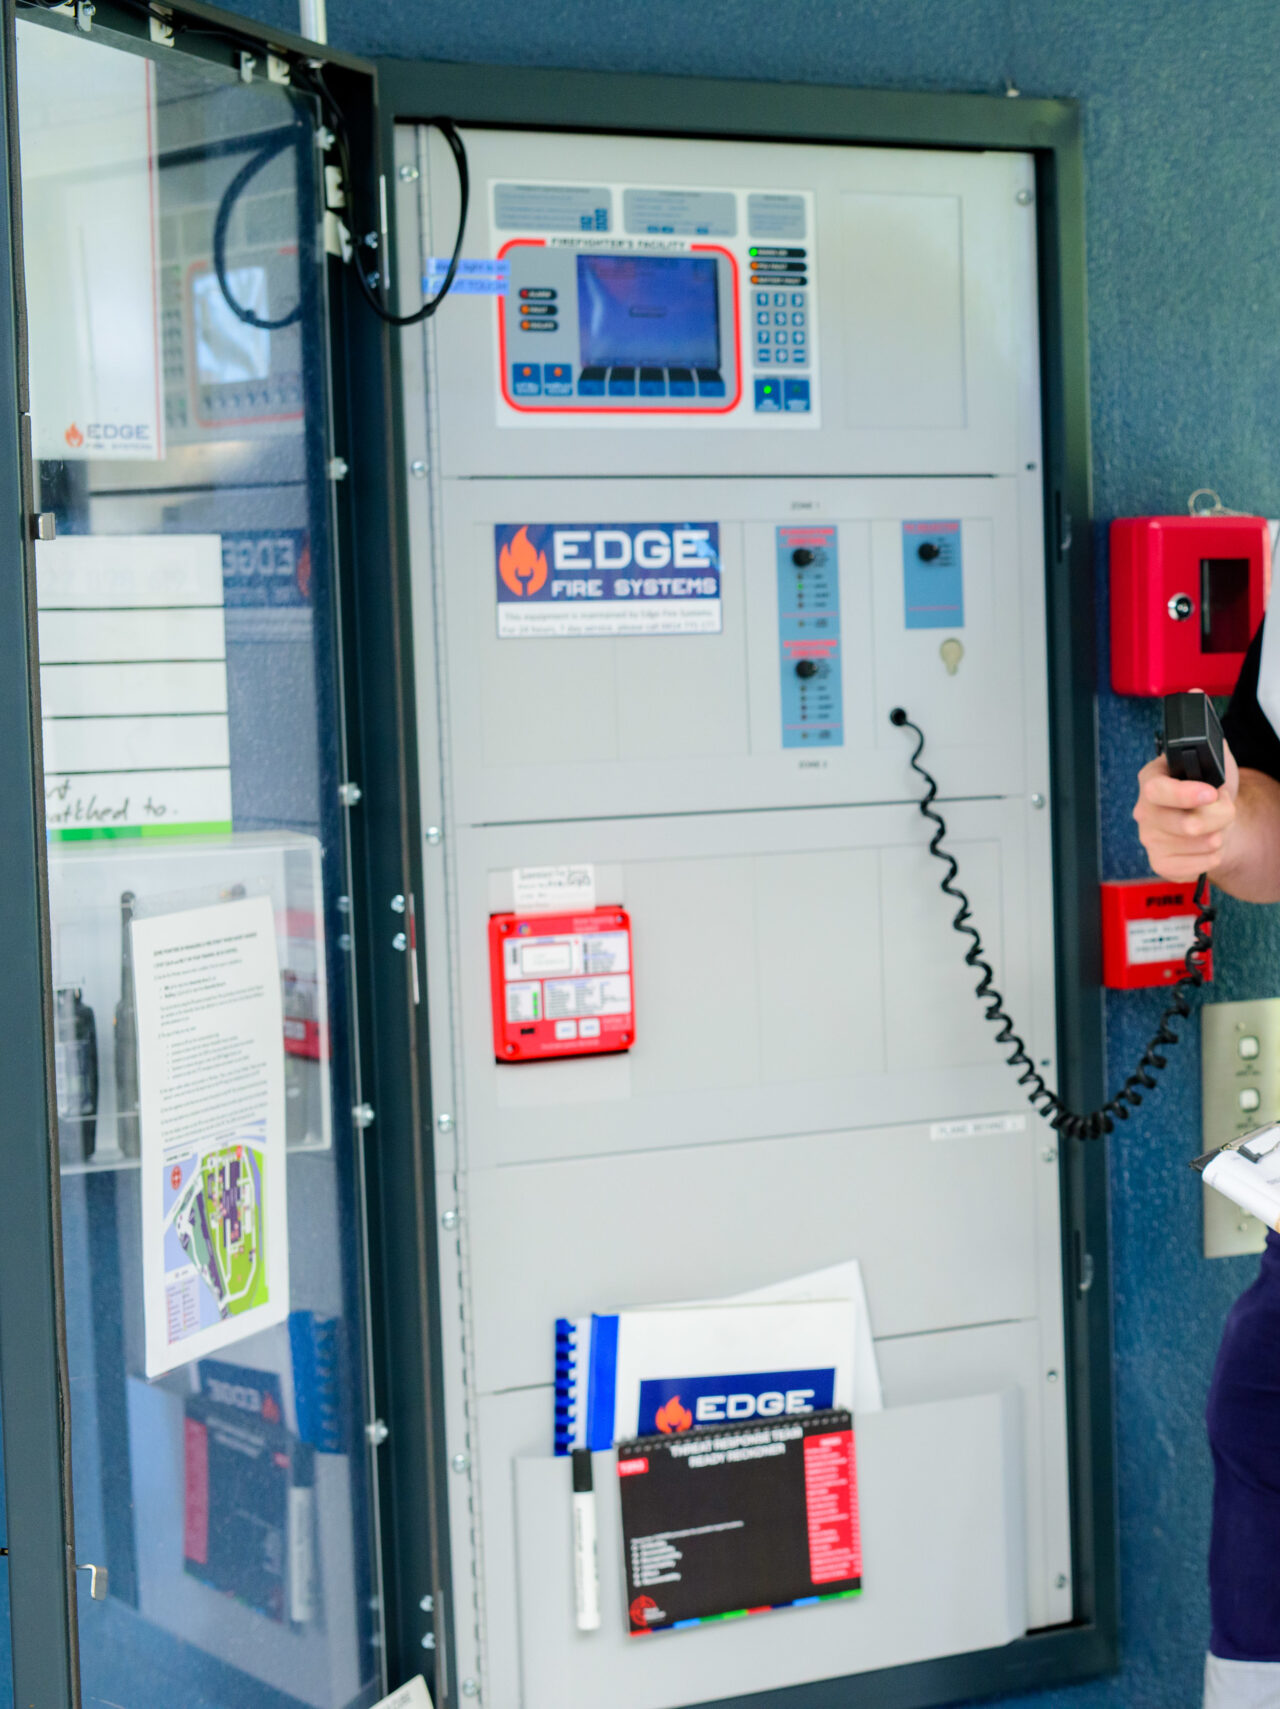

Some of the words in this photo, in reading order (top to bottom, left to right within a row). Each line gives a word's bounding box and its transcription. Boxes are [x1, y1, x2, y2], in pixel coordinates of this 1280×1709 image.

[87, 424, 149, 439] EDGE
[553, 529, 710, 570] EDGE
[551, 579, 603, 597] FIRE
[614, 577, 717, 596] SYSTEMS
[1146, 894, 1184, 908] FIRE
[696, 1389, 815, 1421] EDGE
[713, 1432, 770, 1451] RESPONSE
[772, 1427, 803, 1441] TEAM
[688, 1453, 726, 1469] READY
